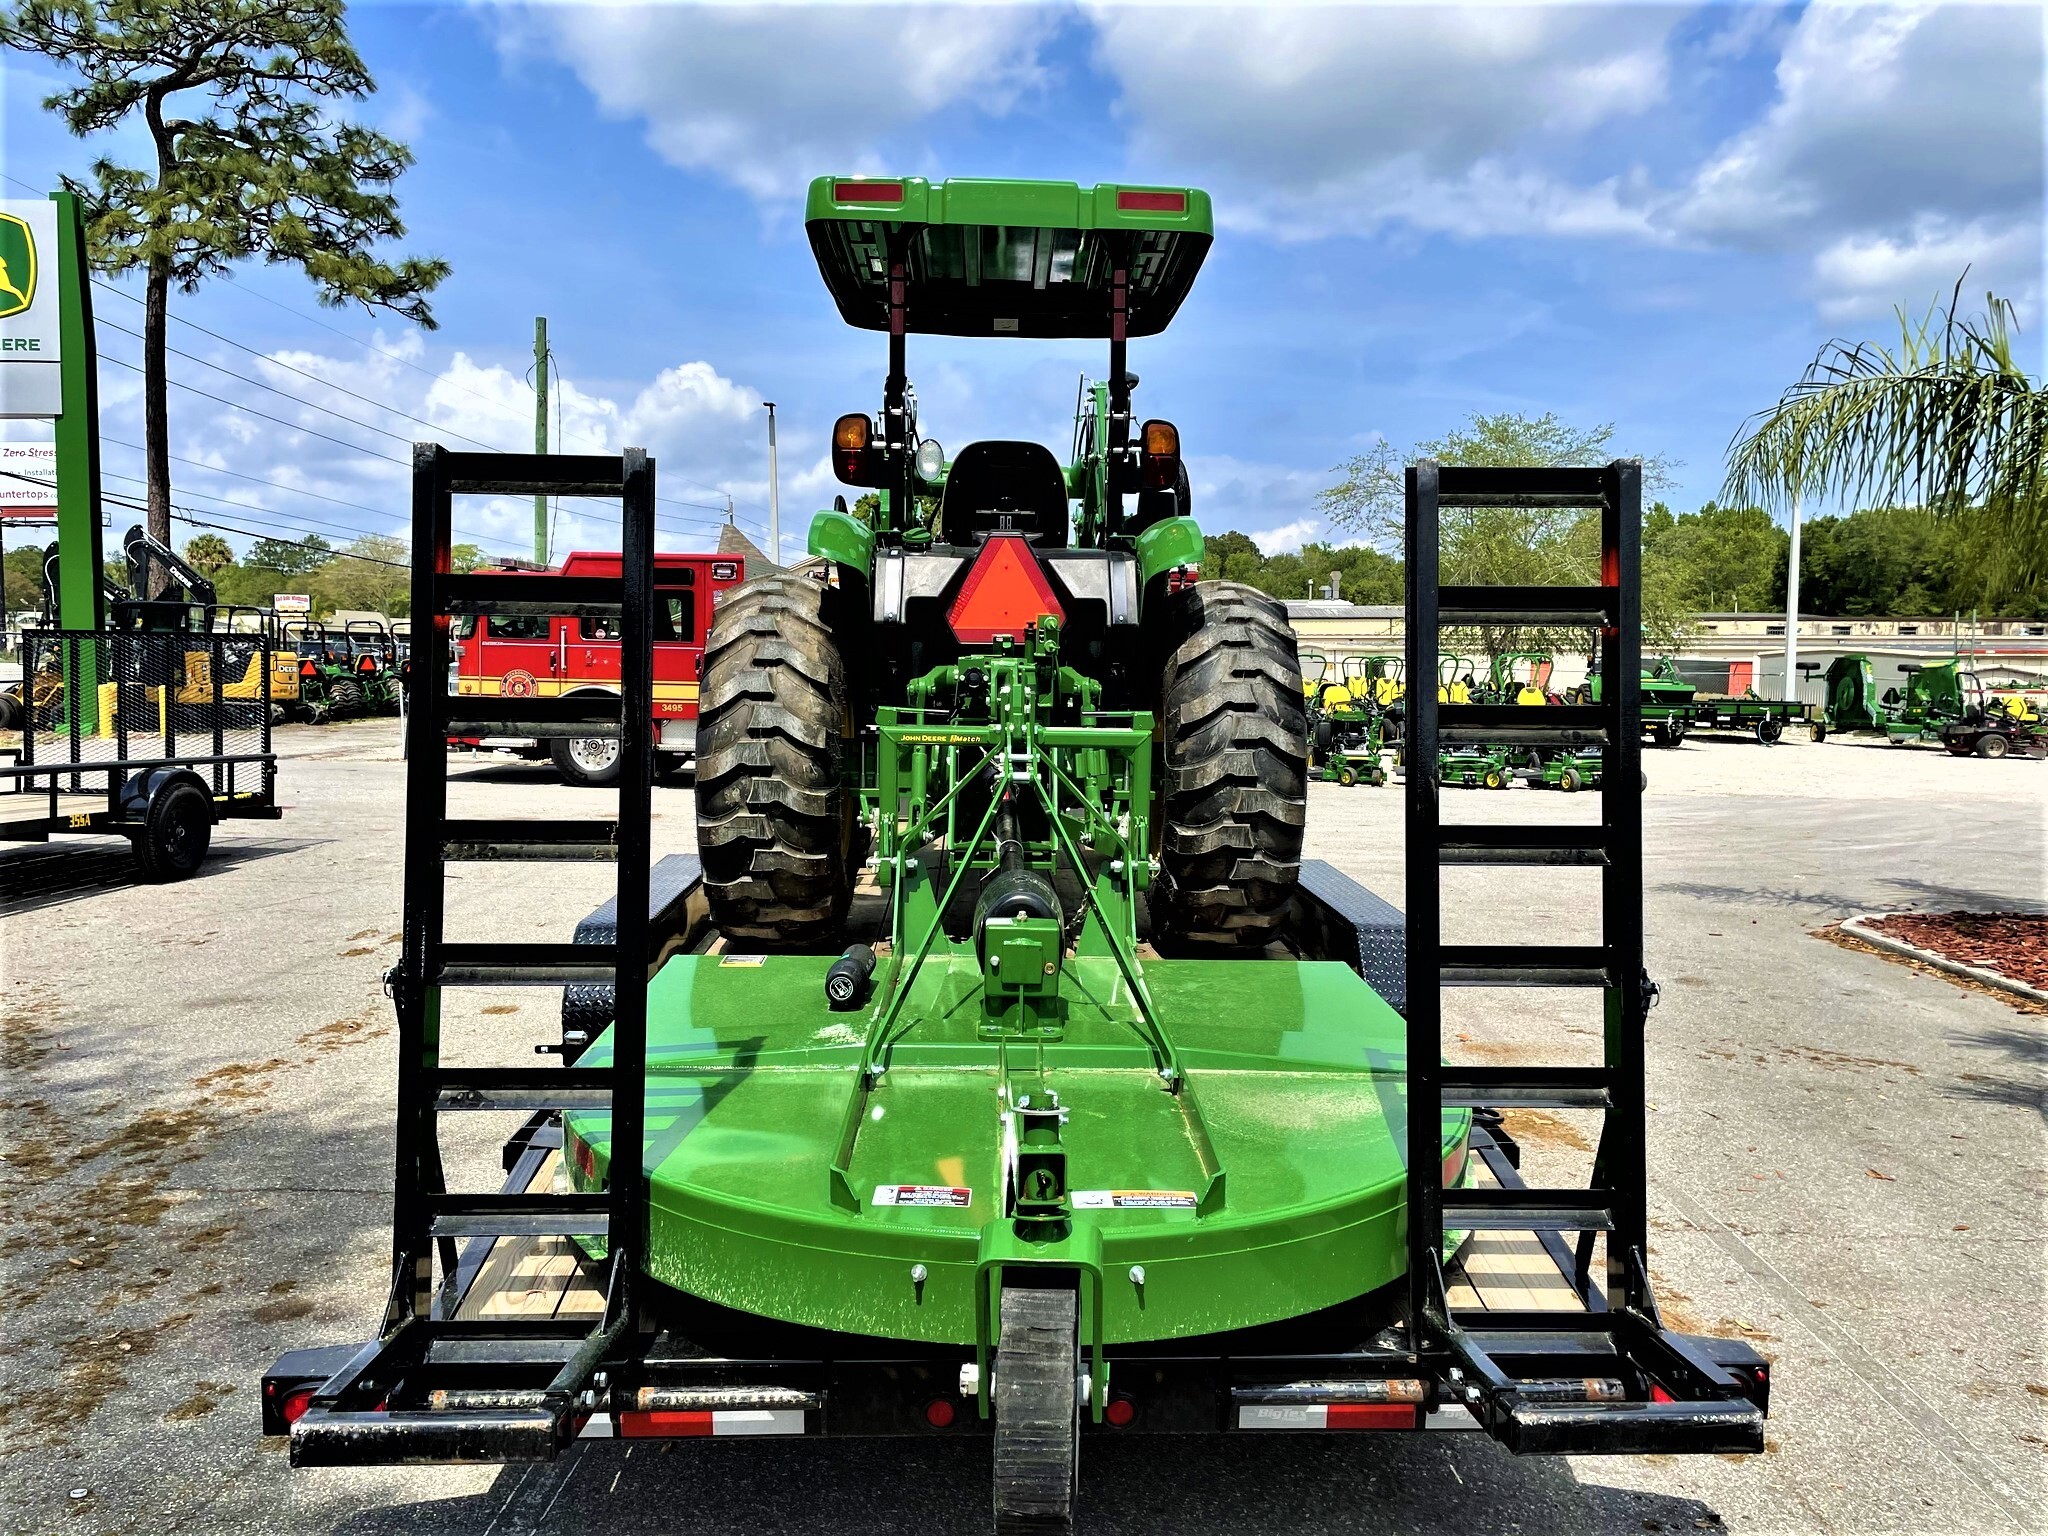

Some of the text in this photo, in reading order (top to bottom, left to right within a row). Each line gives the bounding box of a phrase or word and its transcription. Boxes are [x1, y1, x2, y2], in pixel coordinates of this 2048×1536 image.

[0, 338, 41, 351] ERE
[3, 448, 26, 457] Zero
[661, 703, 684, 713] 3495
